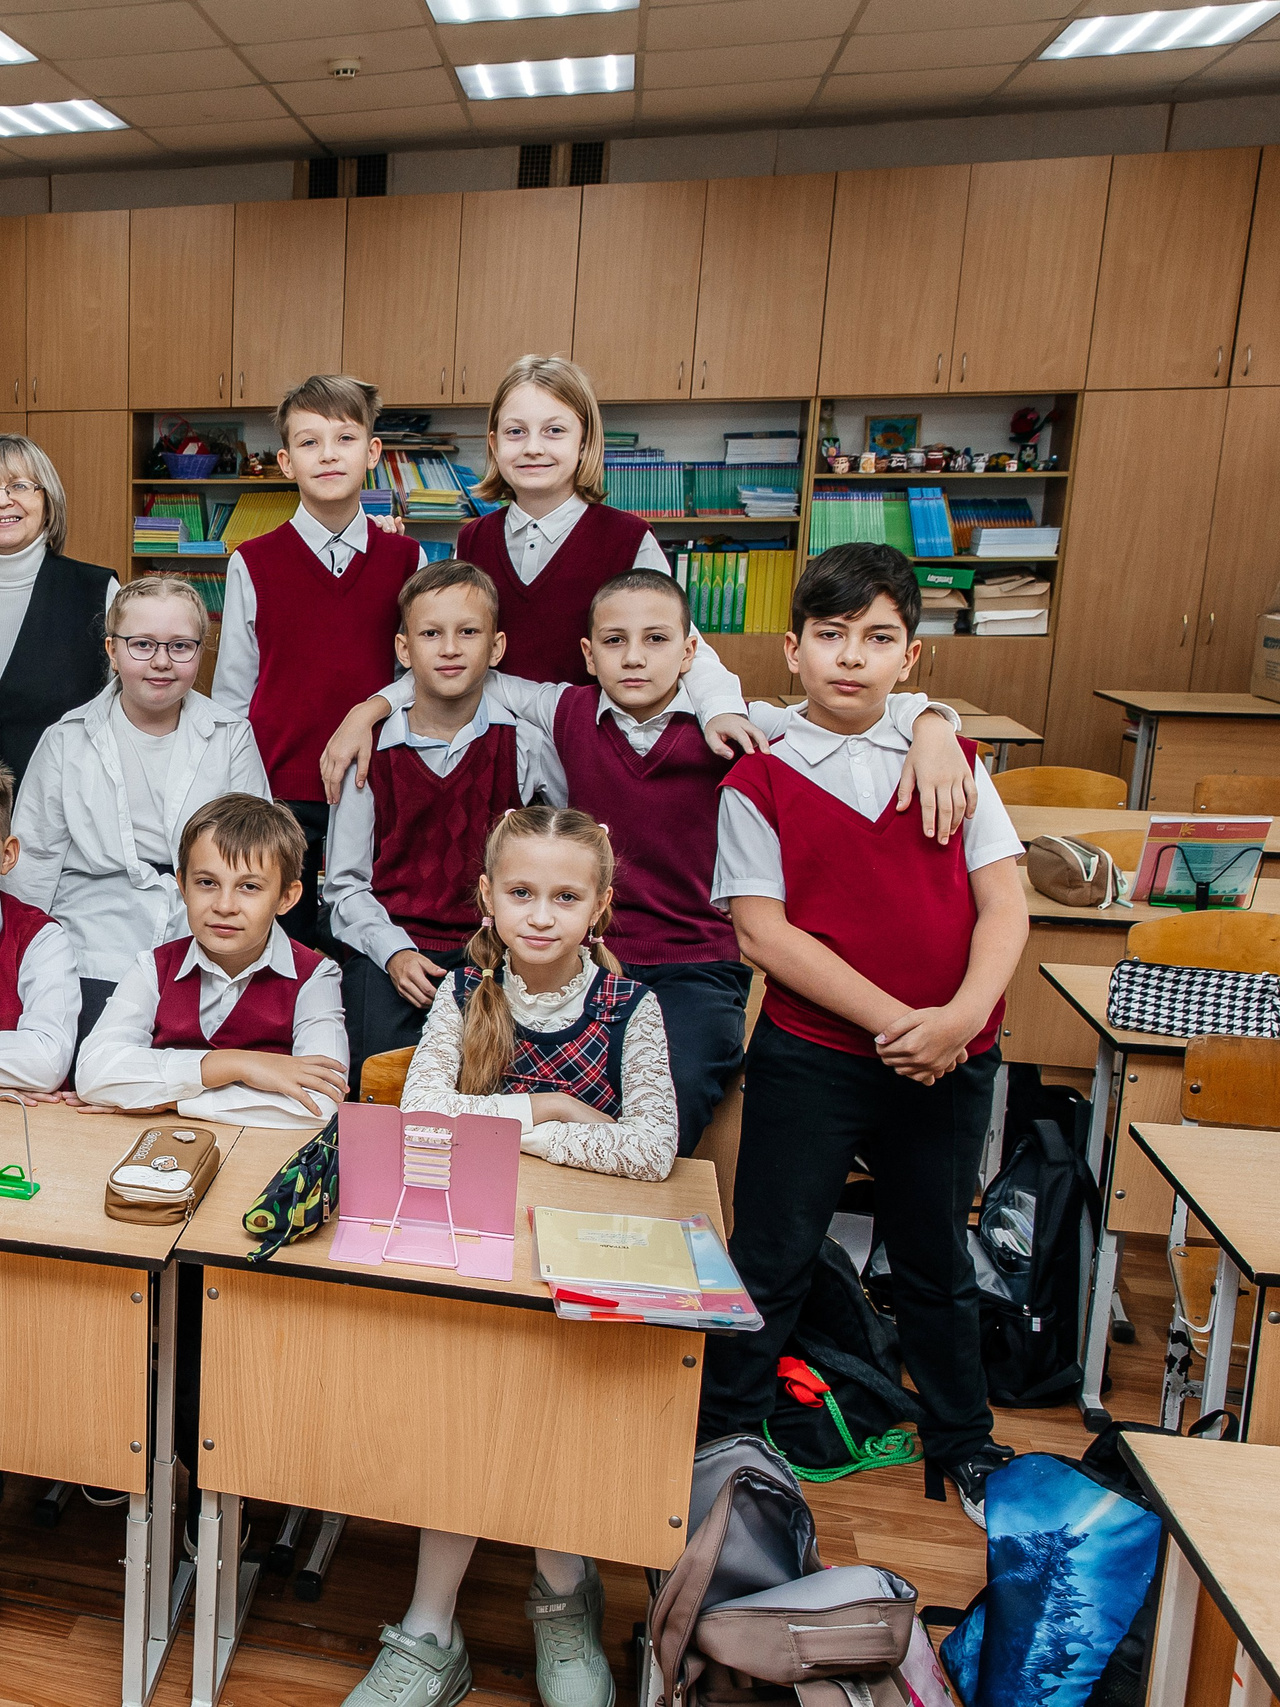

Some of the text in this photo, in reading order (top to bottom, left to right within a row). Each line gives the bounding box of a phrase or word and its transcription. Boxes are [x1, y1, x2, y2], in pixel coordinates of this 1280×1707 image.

[536, 1603, 566, 1613] TIME JUMP
[385, 1630, 417, 1646] TIME JUMP
